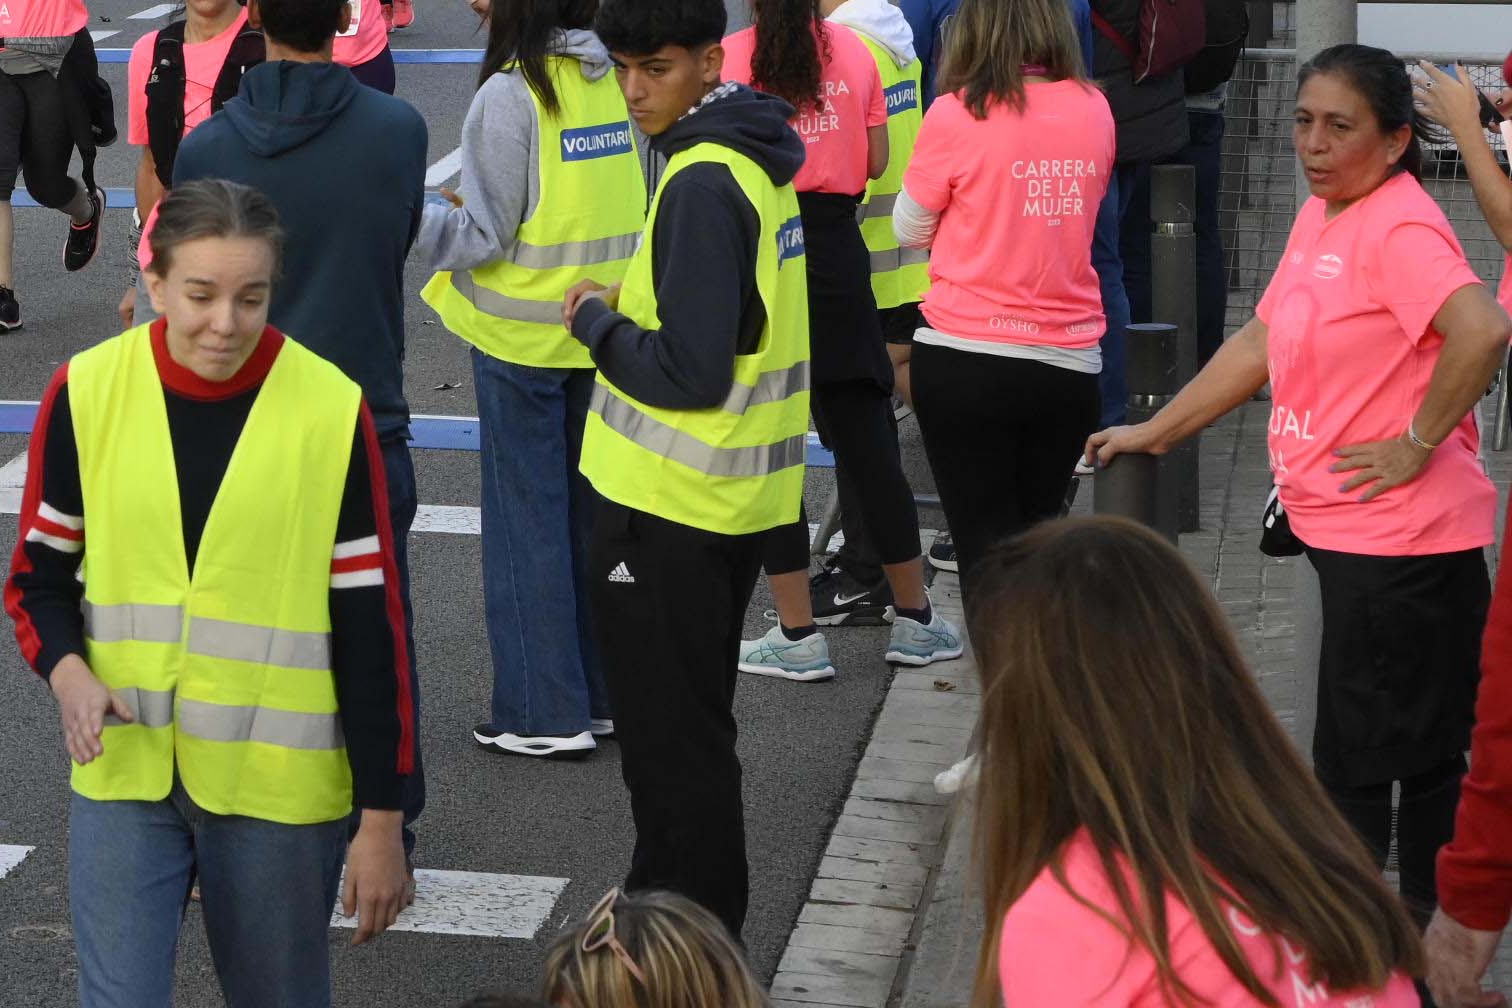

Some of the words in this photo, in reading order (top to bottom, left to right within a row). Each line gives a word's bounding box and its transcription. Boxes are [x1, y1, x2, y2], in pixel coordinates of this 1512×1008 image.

[1011, 159, 1097, 178] CARRERA
[1028, 179, 1052, 198] DE
[1059, 179, 1081, 197] LA
[1023, 198, 1084, 217] MUJER
[989, 316, 1040, 335] OYSHO
[608, 574, 635, 584] adidas
